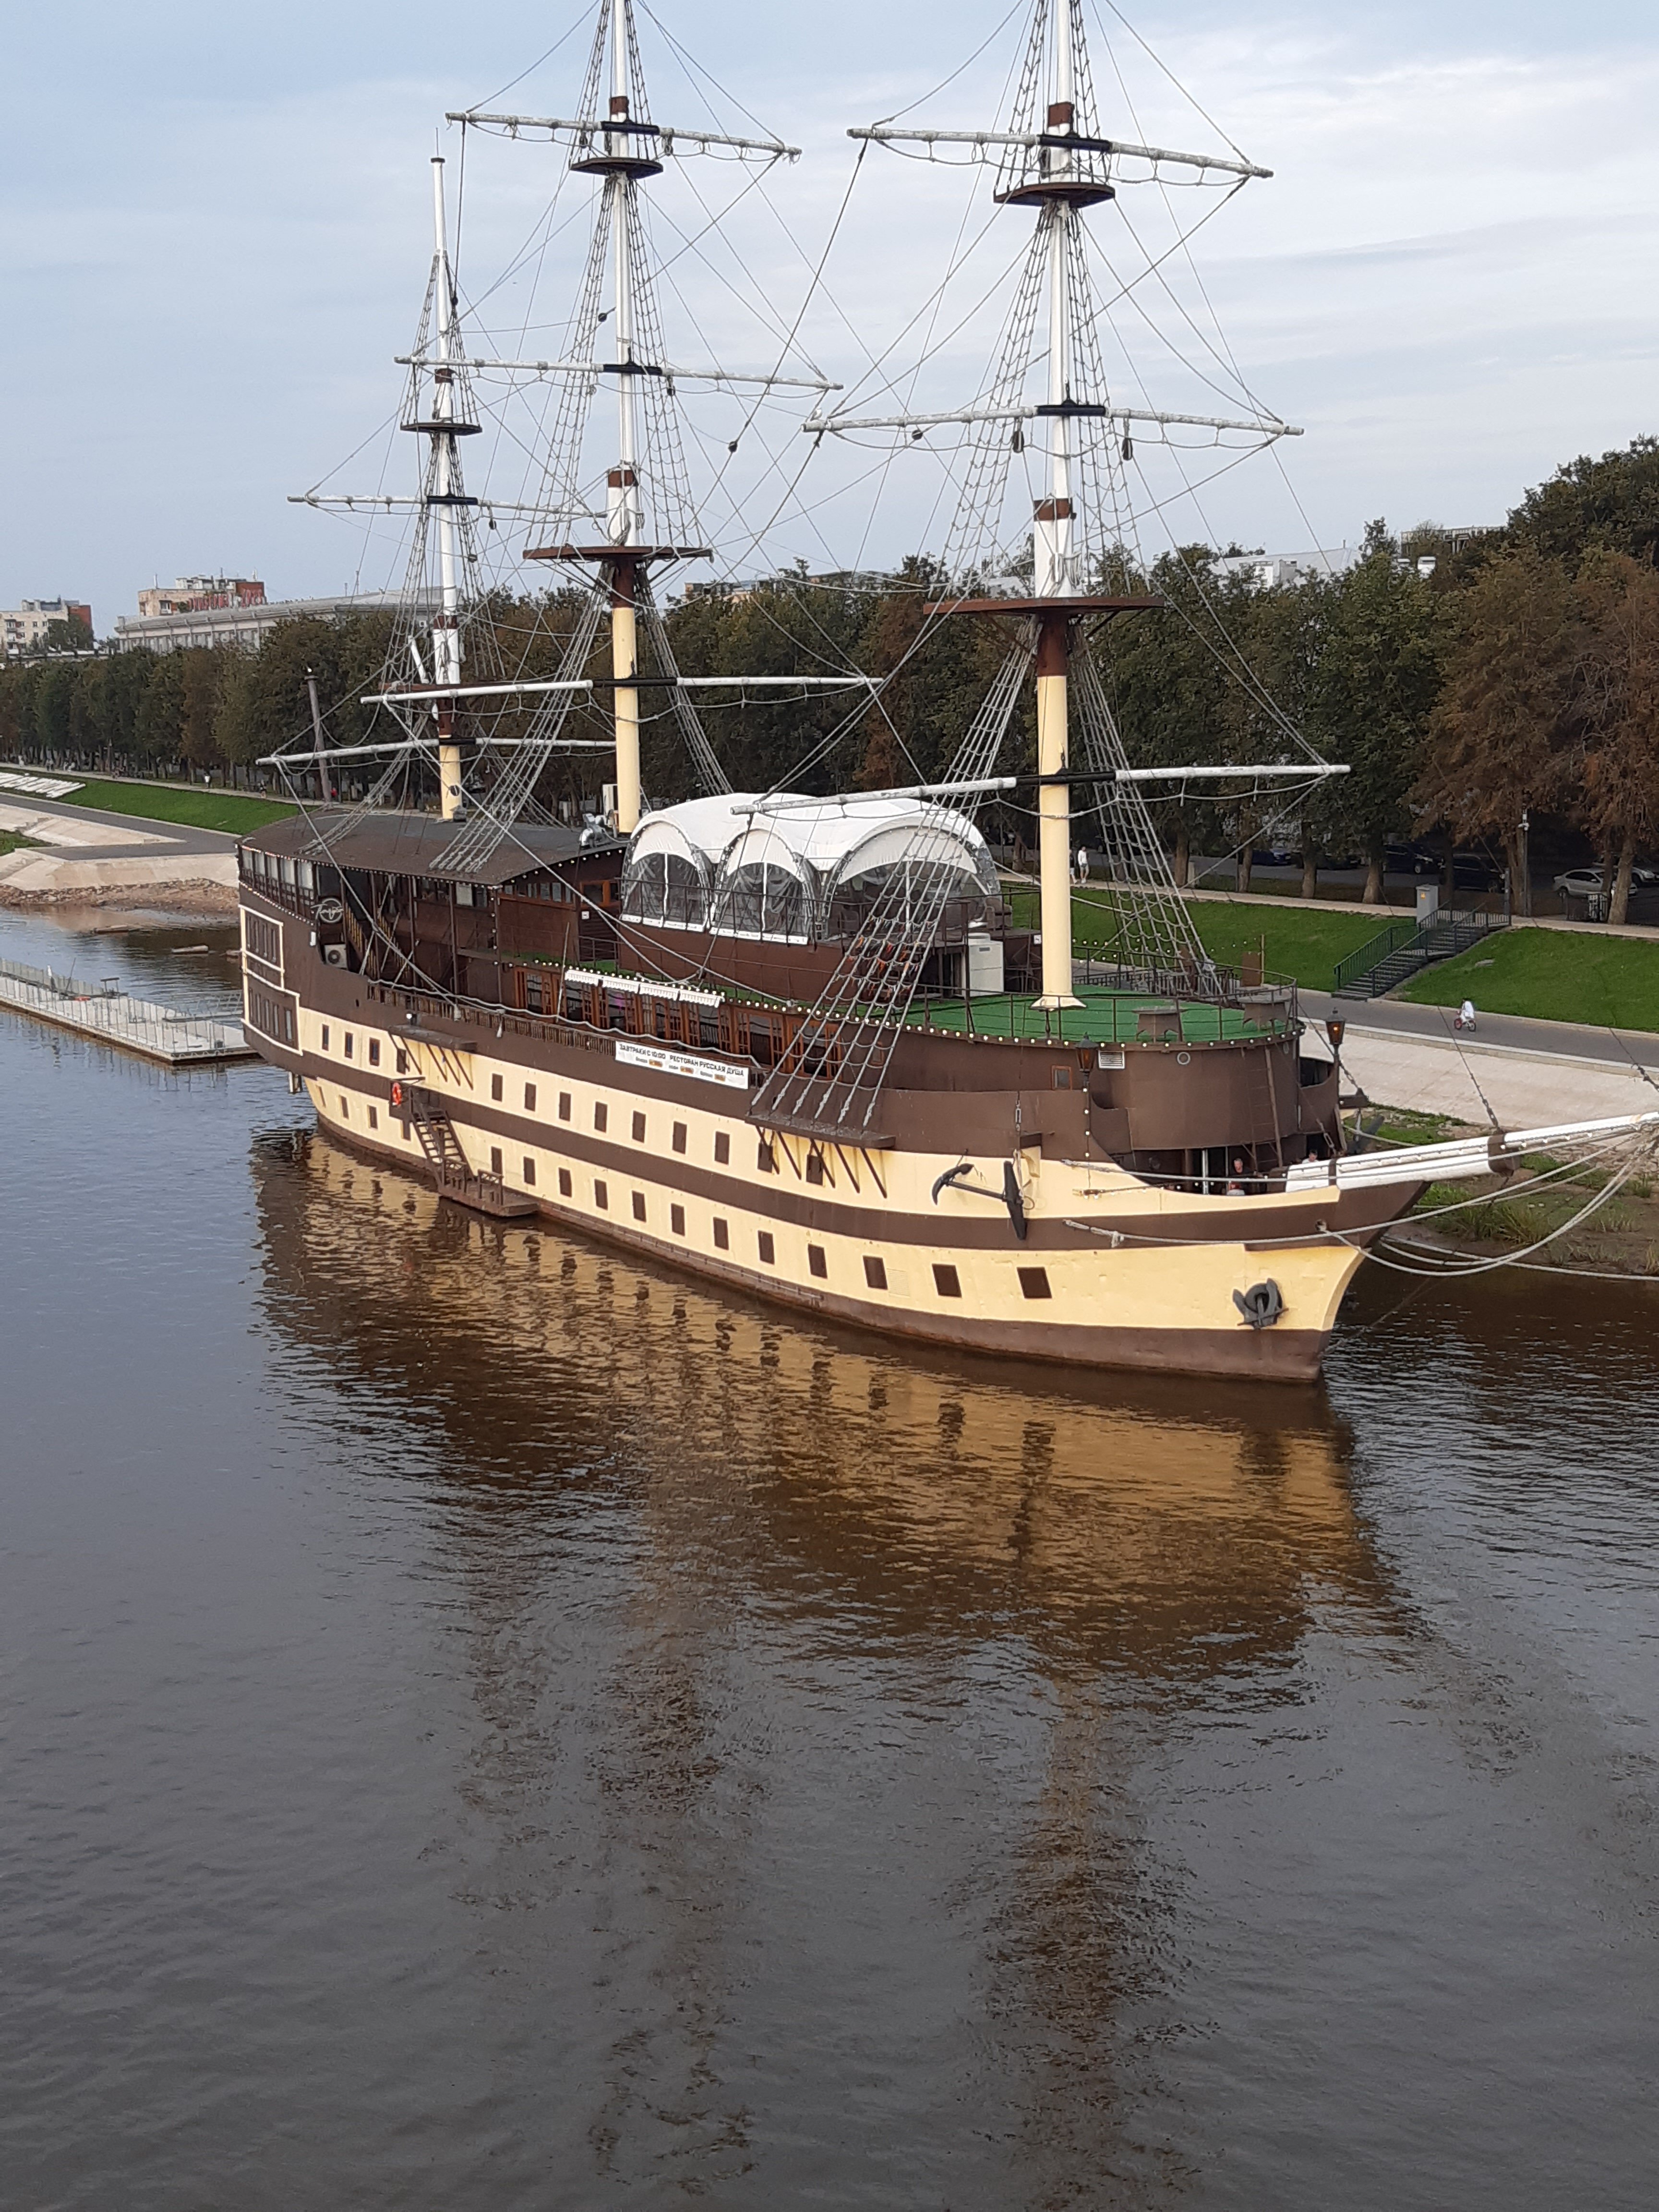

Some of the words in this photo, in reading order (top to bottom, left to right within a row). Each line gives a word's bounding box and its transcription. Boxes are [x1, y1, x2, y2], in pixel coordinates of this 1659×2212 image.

[670, 1055, 698, 1066] РЕСТОРАН
[699, 1061, 725, 1072] РУССКАЯ
[726, 1067, 744, 1076] ДУША
